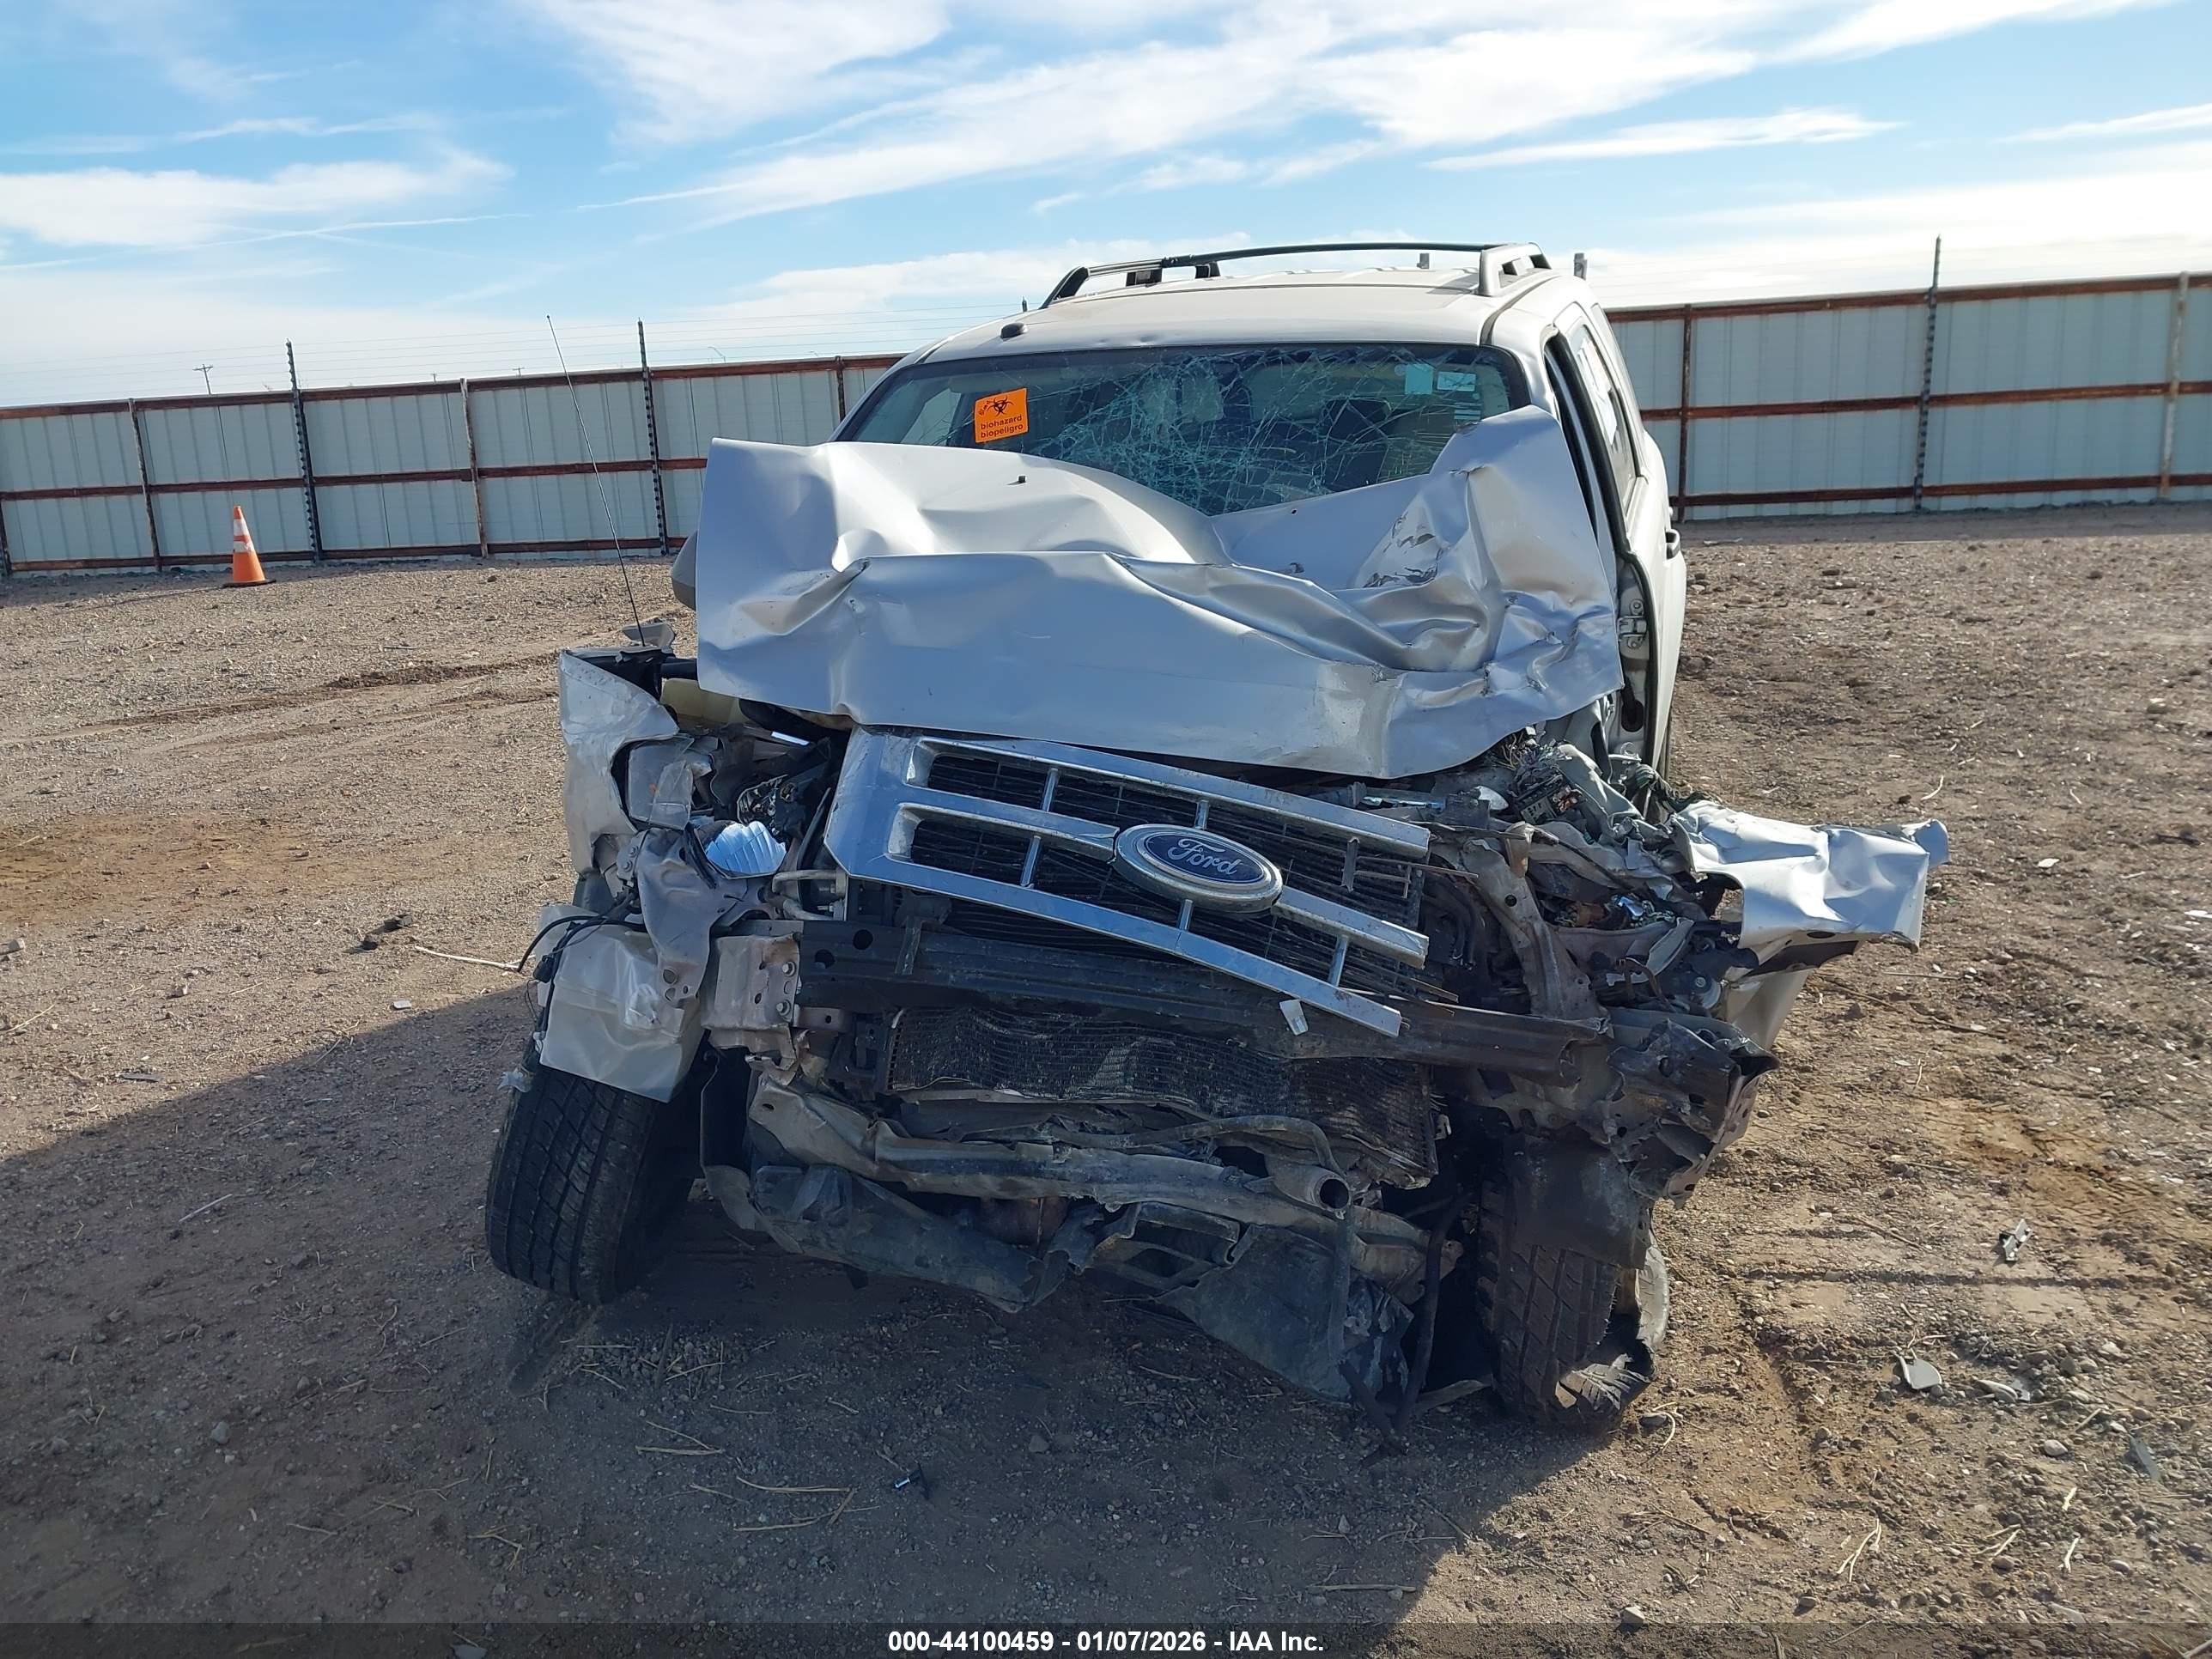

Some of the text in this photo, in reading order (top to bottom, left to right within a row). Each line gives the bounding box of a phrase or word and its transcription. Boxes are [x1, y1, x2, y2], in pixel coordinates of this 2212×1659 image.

[981, 414, 1022, 429] biohazard
[981, 423, 1023, 438] biopeligro
[1167, 838, 1242, 875] Ford
